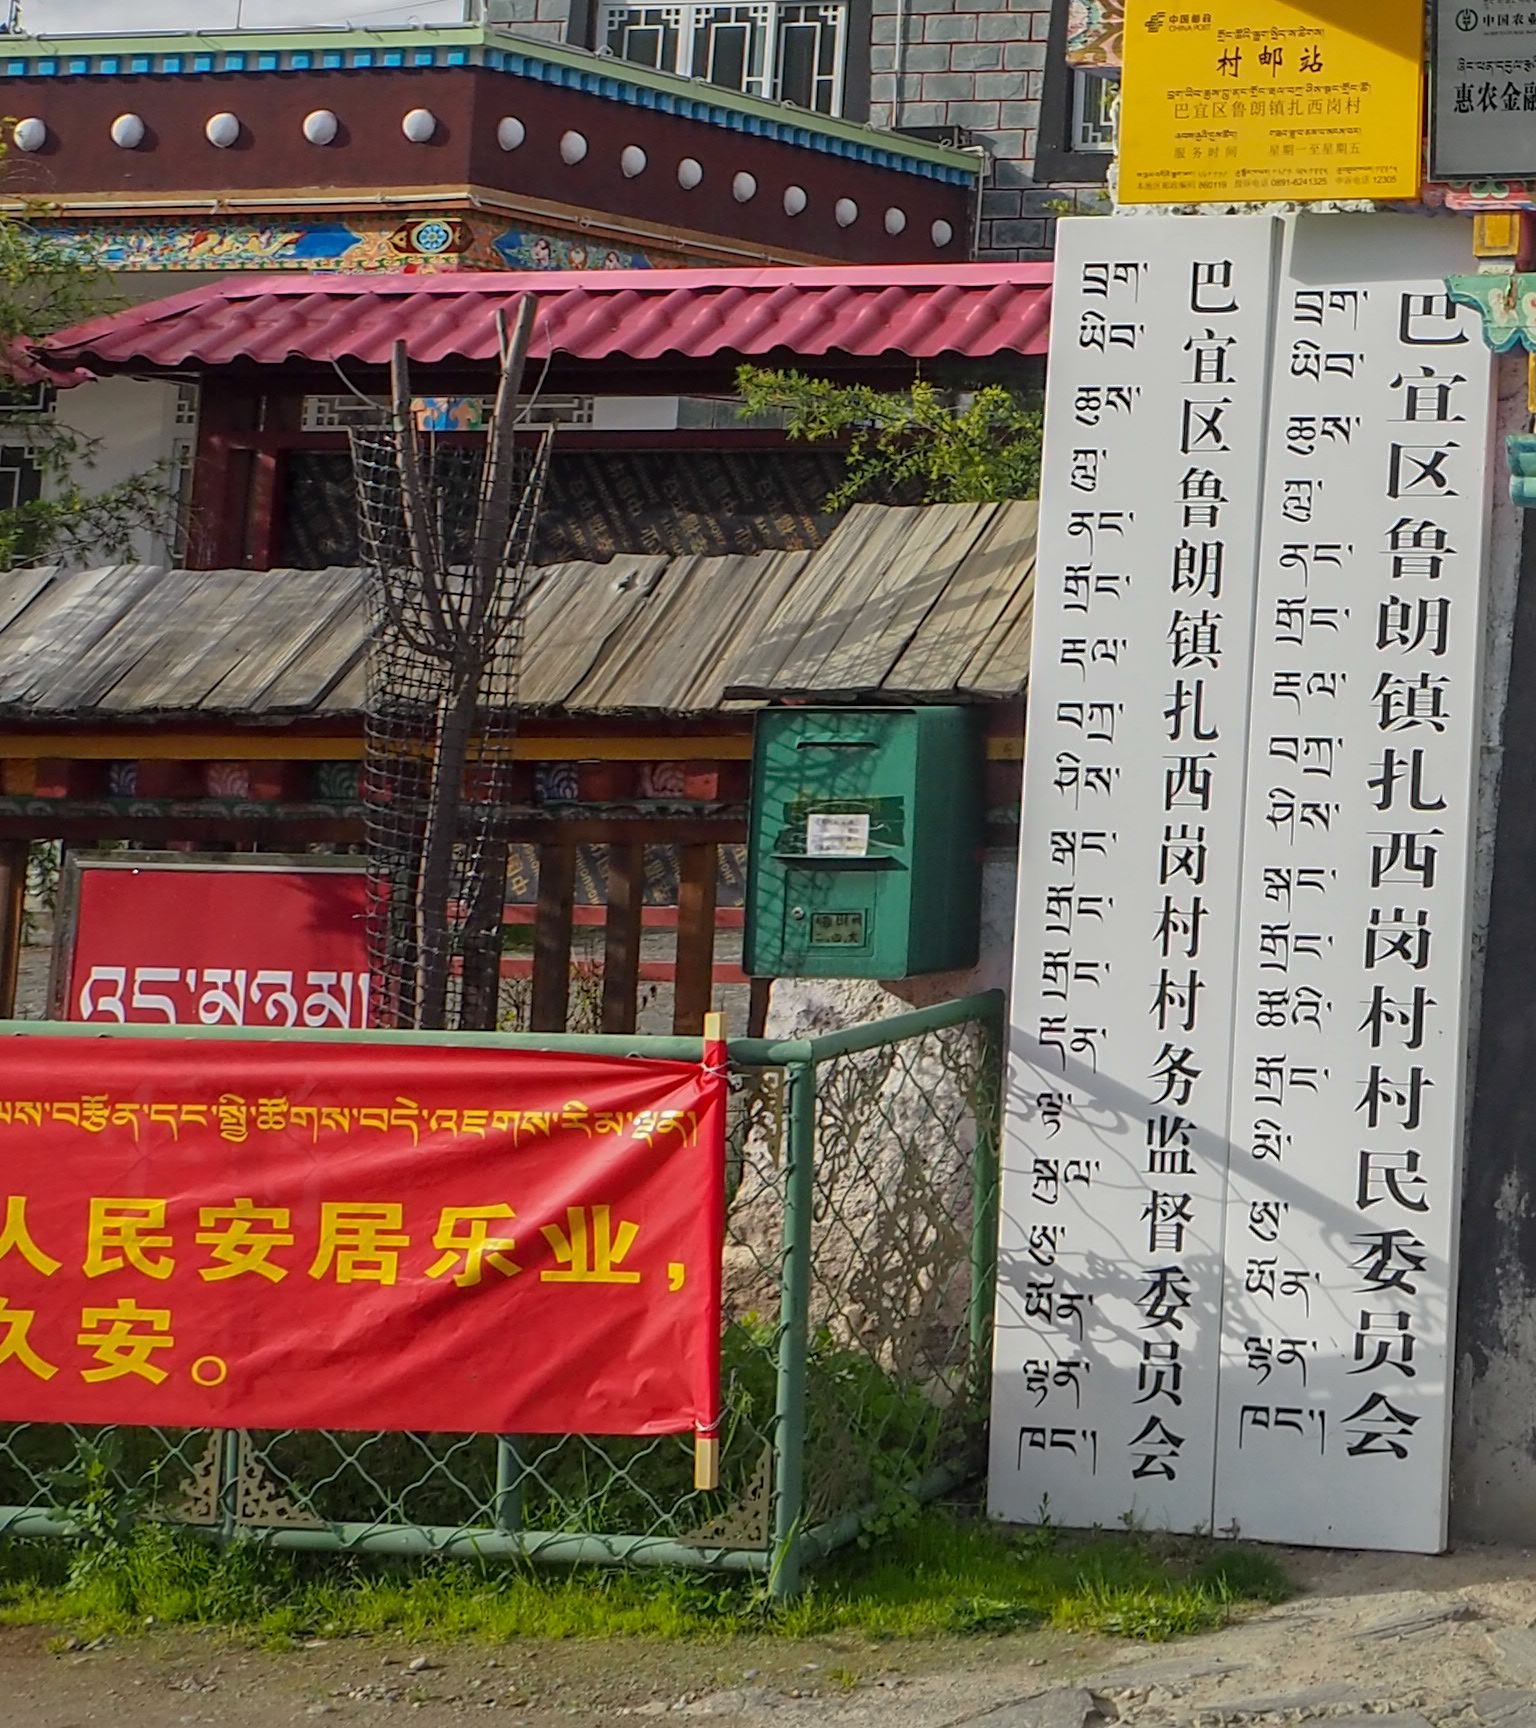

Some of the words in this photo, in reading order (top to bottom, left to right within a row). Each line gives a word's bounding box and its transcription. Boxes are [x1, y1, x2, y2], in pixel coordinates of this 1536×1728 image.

[1216, 45, 1324, 78] 村邮站
[1174, 96, 1361, 119] 巴宜区鲁朗镇扎西岗村
[1269, 143, 1360, 157] 星期一至星期五
[1372, 175, 1397, 184] 12305
[1127, 259, 1239, 1481] 巴宜区鲁朗镇扎西岗村村务监督委员会
[1340, 292, 1470, 1460] 巴宜区鲁朗镇扎西岗村村民委员会
